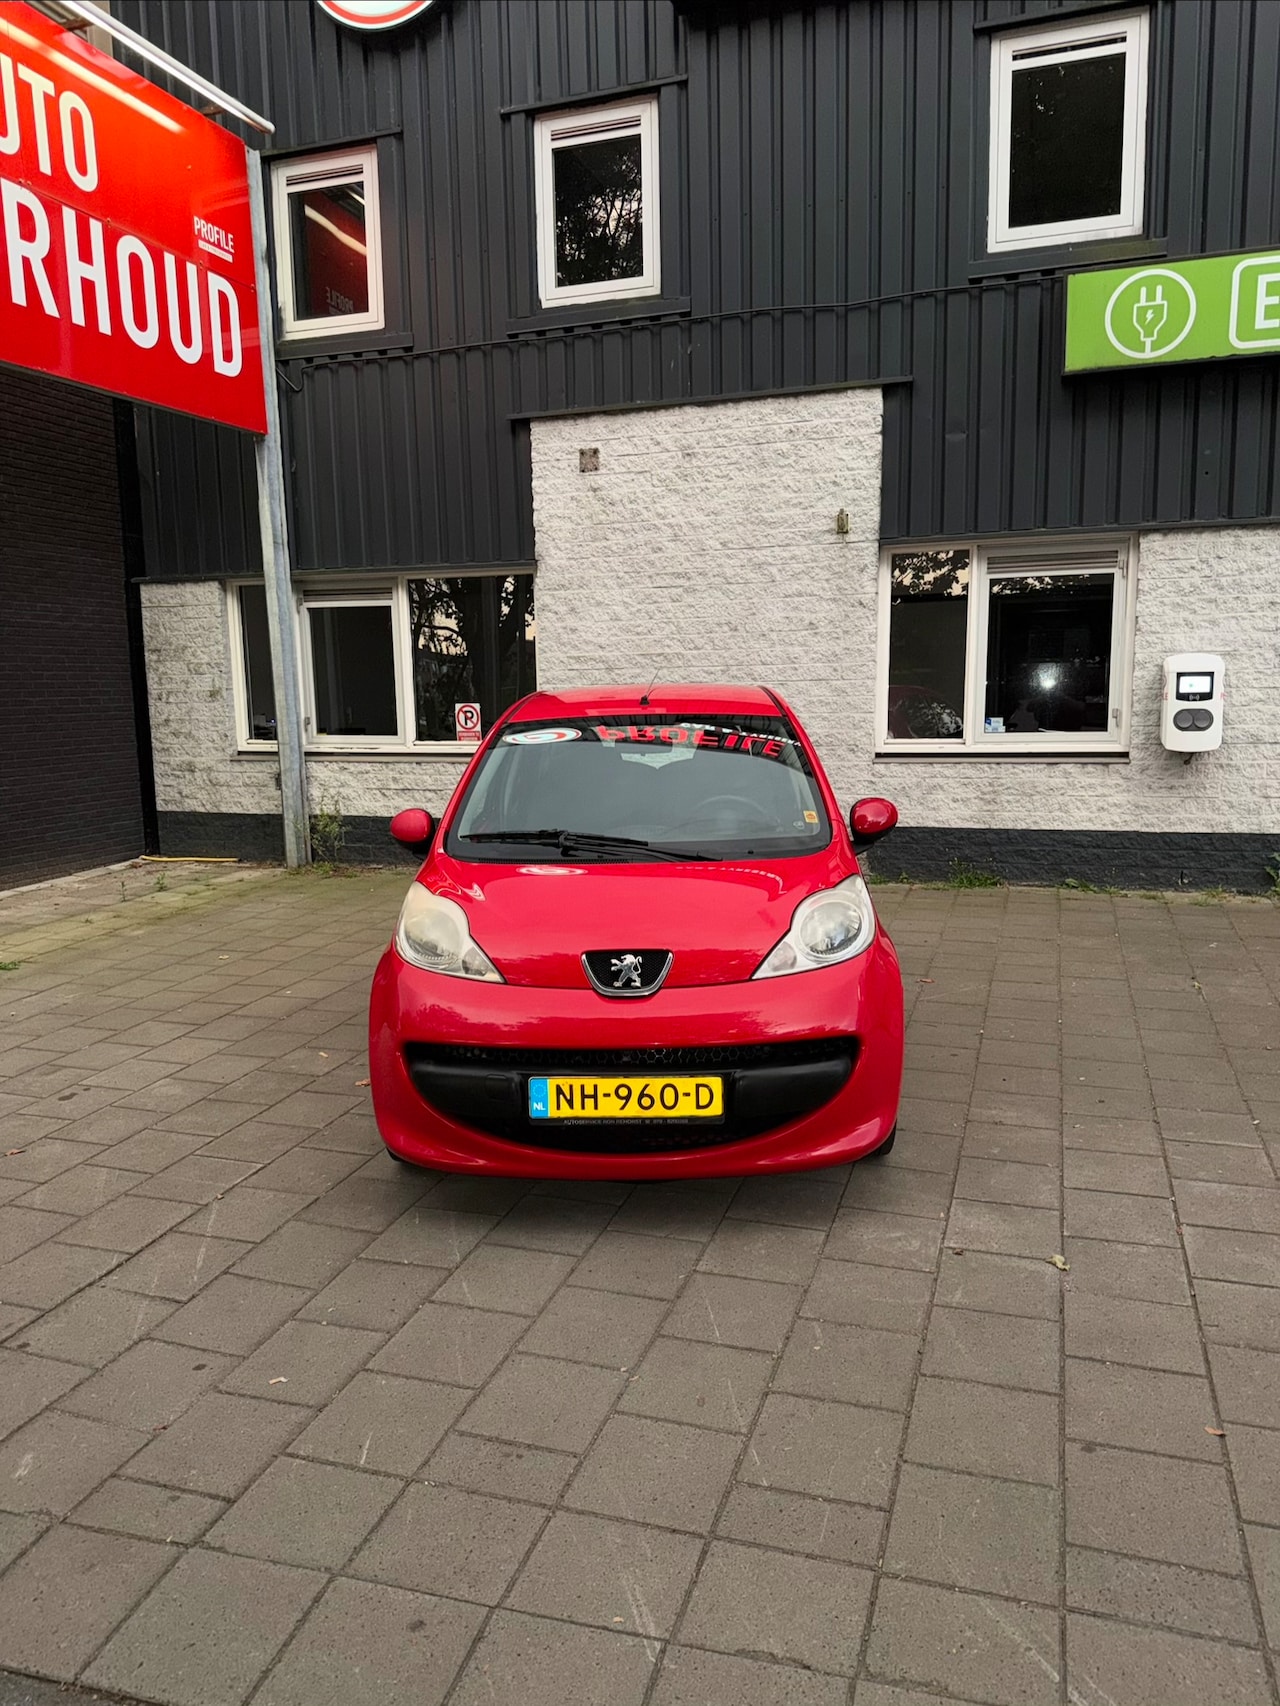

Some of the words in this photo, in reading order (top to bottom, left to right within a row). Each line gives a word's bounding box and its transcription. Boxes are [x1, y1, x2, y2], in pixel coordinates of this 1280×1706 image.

[193, 215, 235, 254] PROFILE
[533, 1101, 546, 1111] NL
[555, 1083, 714, 1111] NH-960-D
